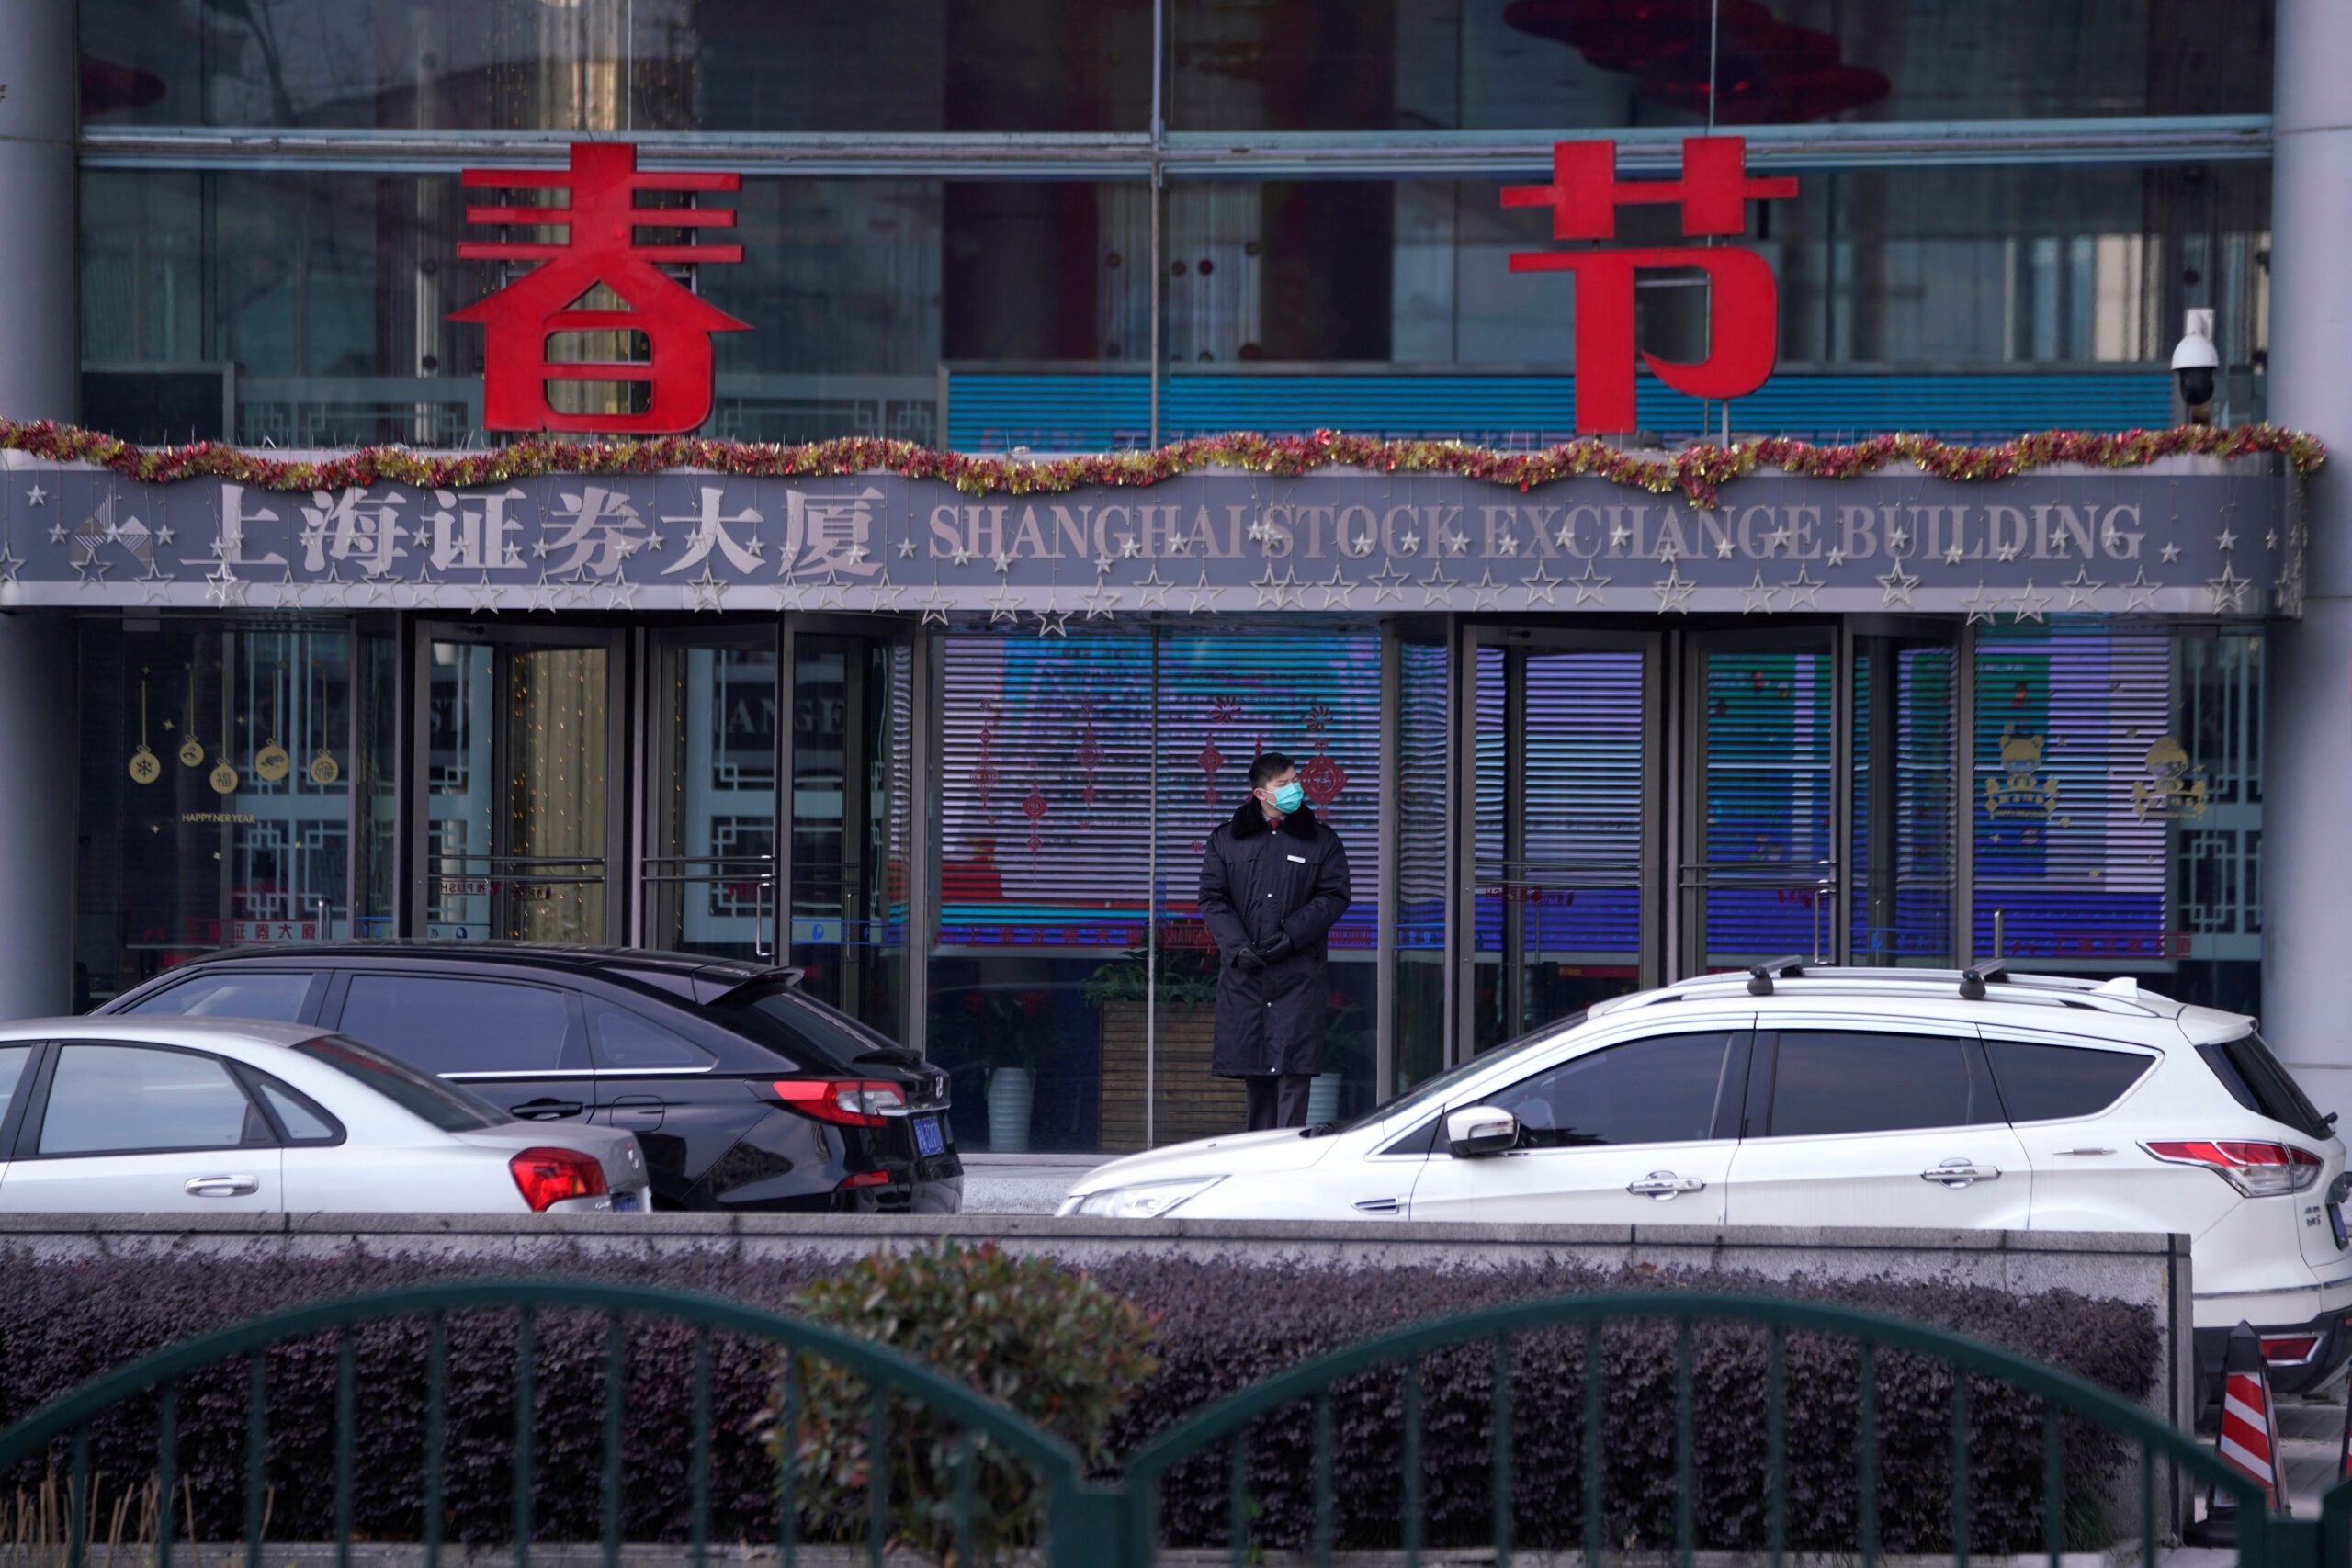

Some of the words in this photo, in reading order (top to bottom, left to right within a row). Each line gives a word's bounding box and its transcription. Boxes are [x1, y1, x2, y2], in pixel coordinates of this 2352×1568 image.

[447, 141, 755, 434] 春
[1500, 135, 1799, 436] 节
[178, 482, 886, 577] 上海证券大厦
[929, 504, 1247, 560] SHANGHAI
[1261, 504, 1476, 560] STOCK
[1479, 504, 1823, 560] EXCHANGE
[1841, 504, 2145, 560] BUILDING
[182, 812, 214, 824] HAPPY
[232, 813, 256, 825] YEAR
